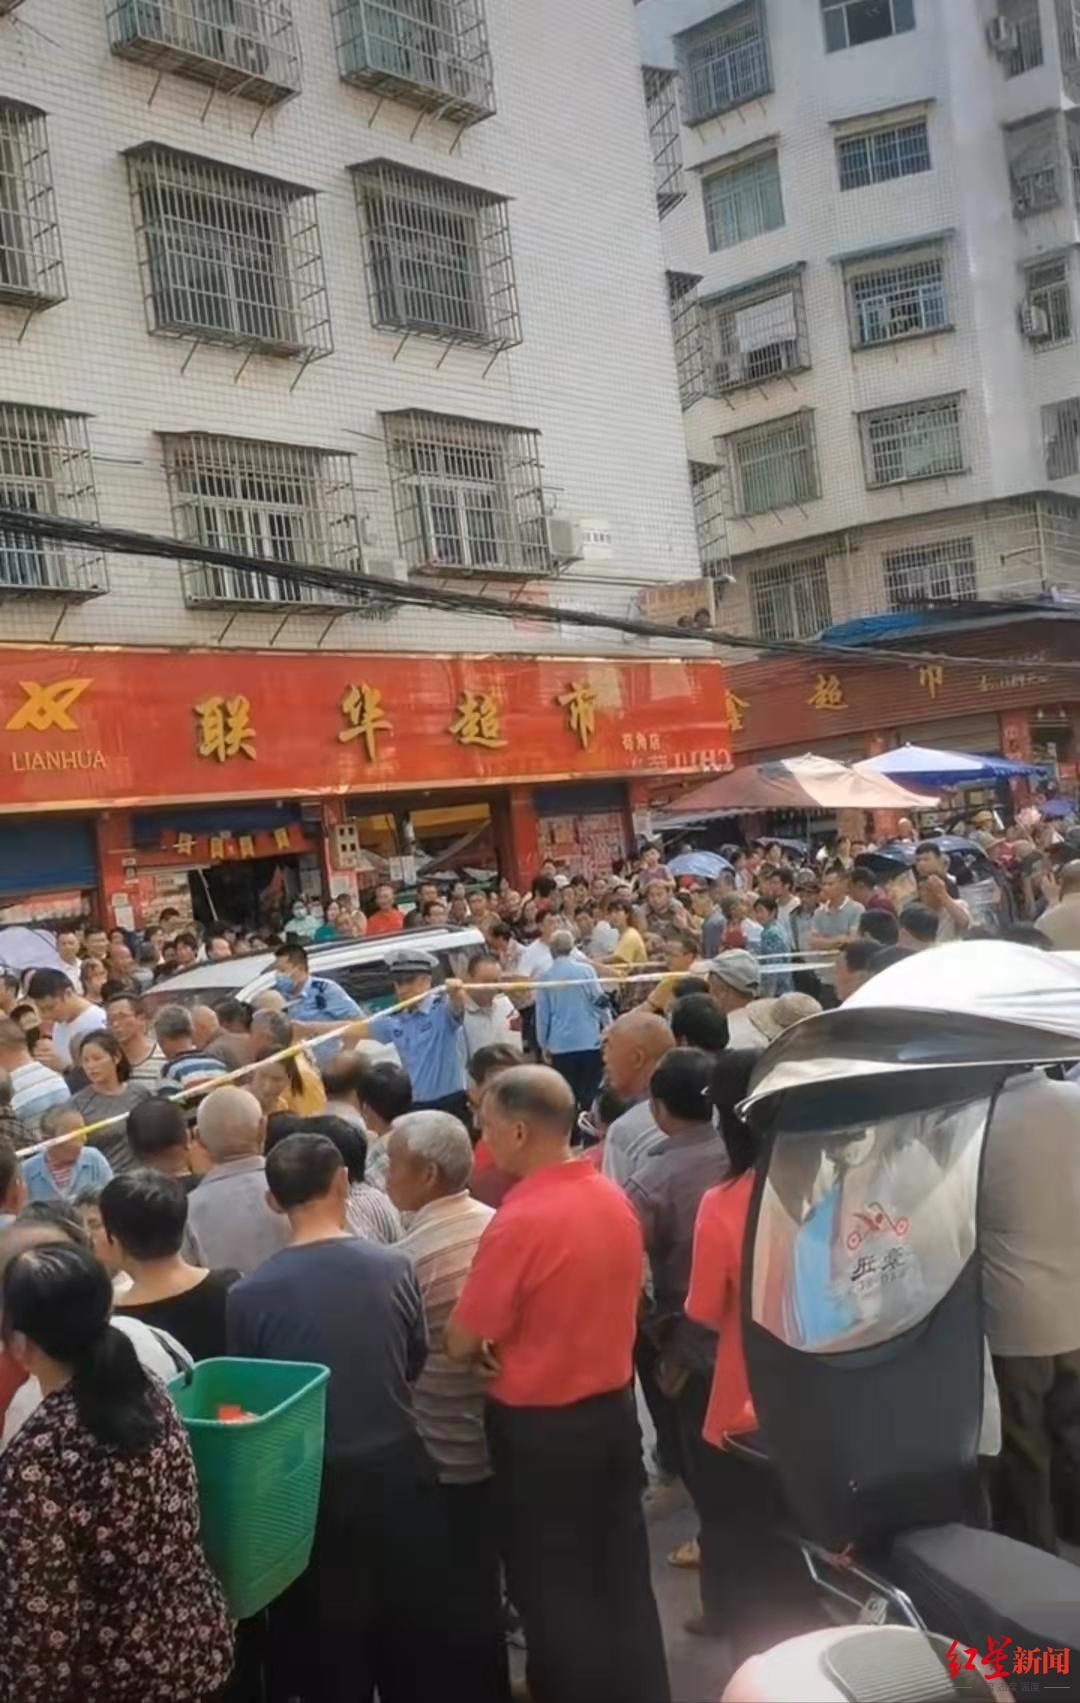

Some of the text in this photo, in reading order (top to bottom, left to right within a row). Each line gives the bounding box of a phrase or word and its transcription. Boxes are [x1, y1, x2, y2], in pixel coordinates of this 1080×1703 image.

[194, 681, 599, 762] 联华超市
[11, 750, 107, 772] LIANHUA
